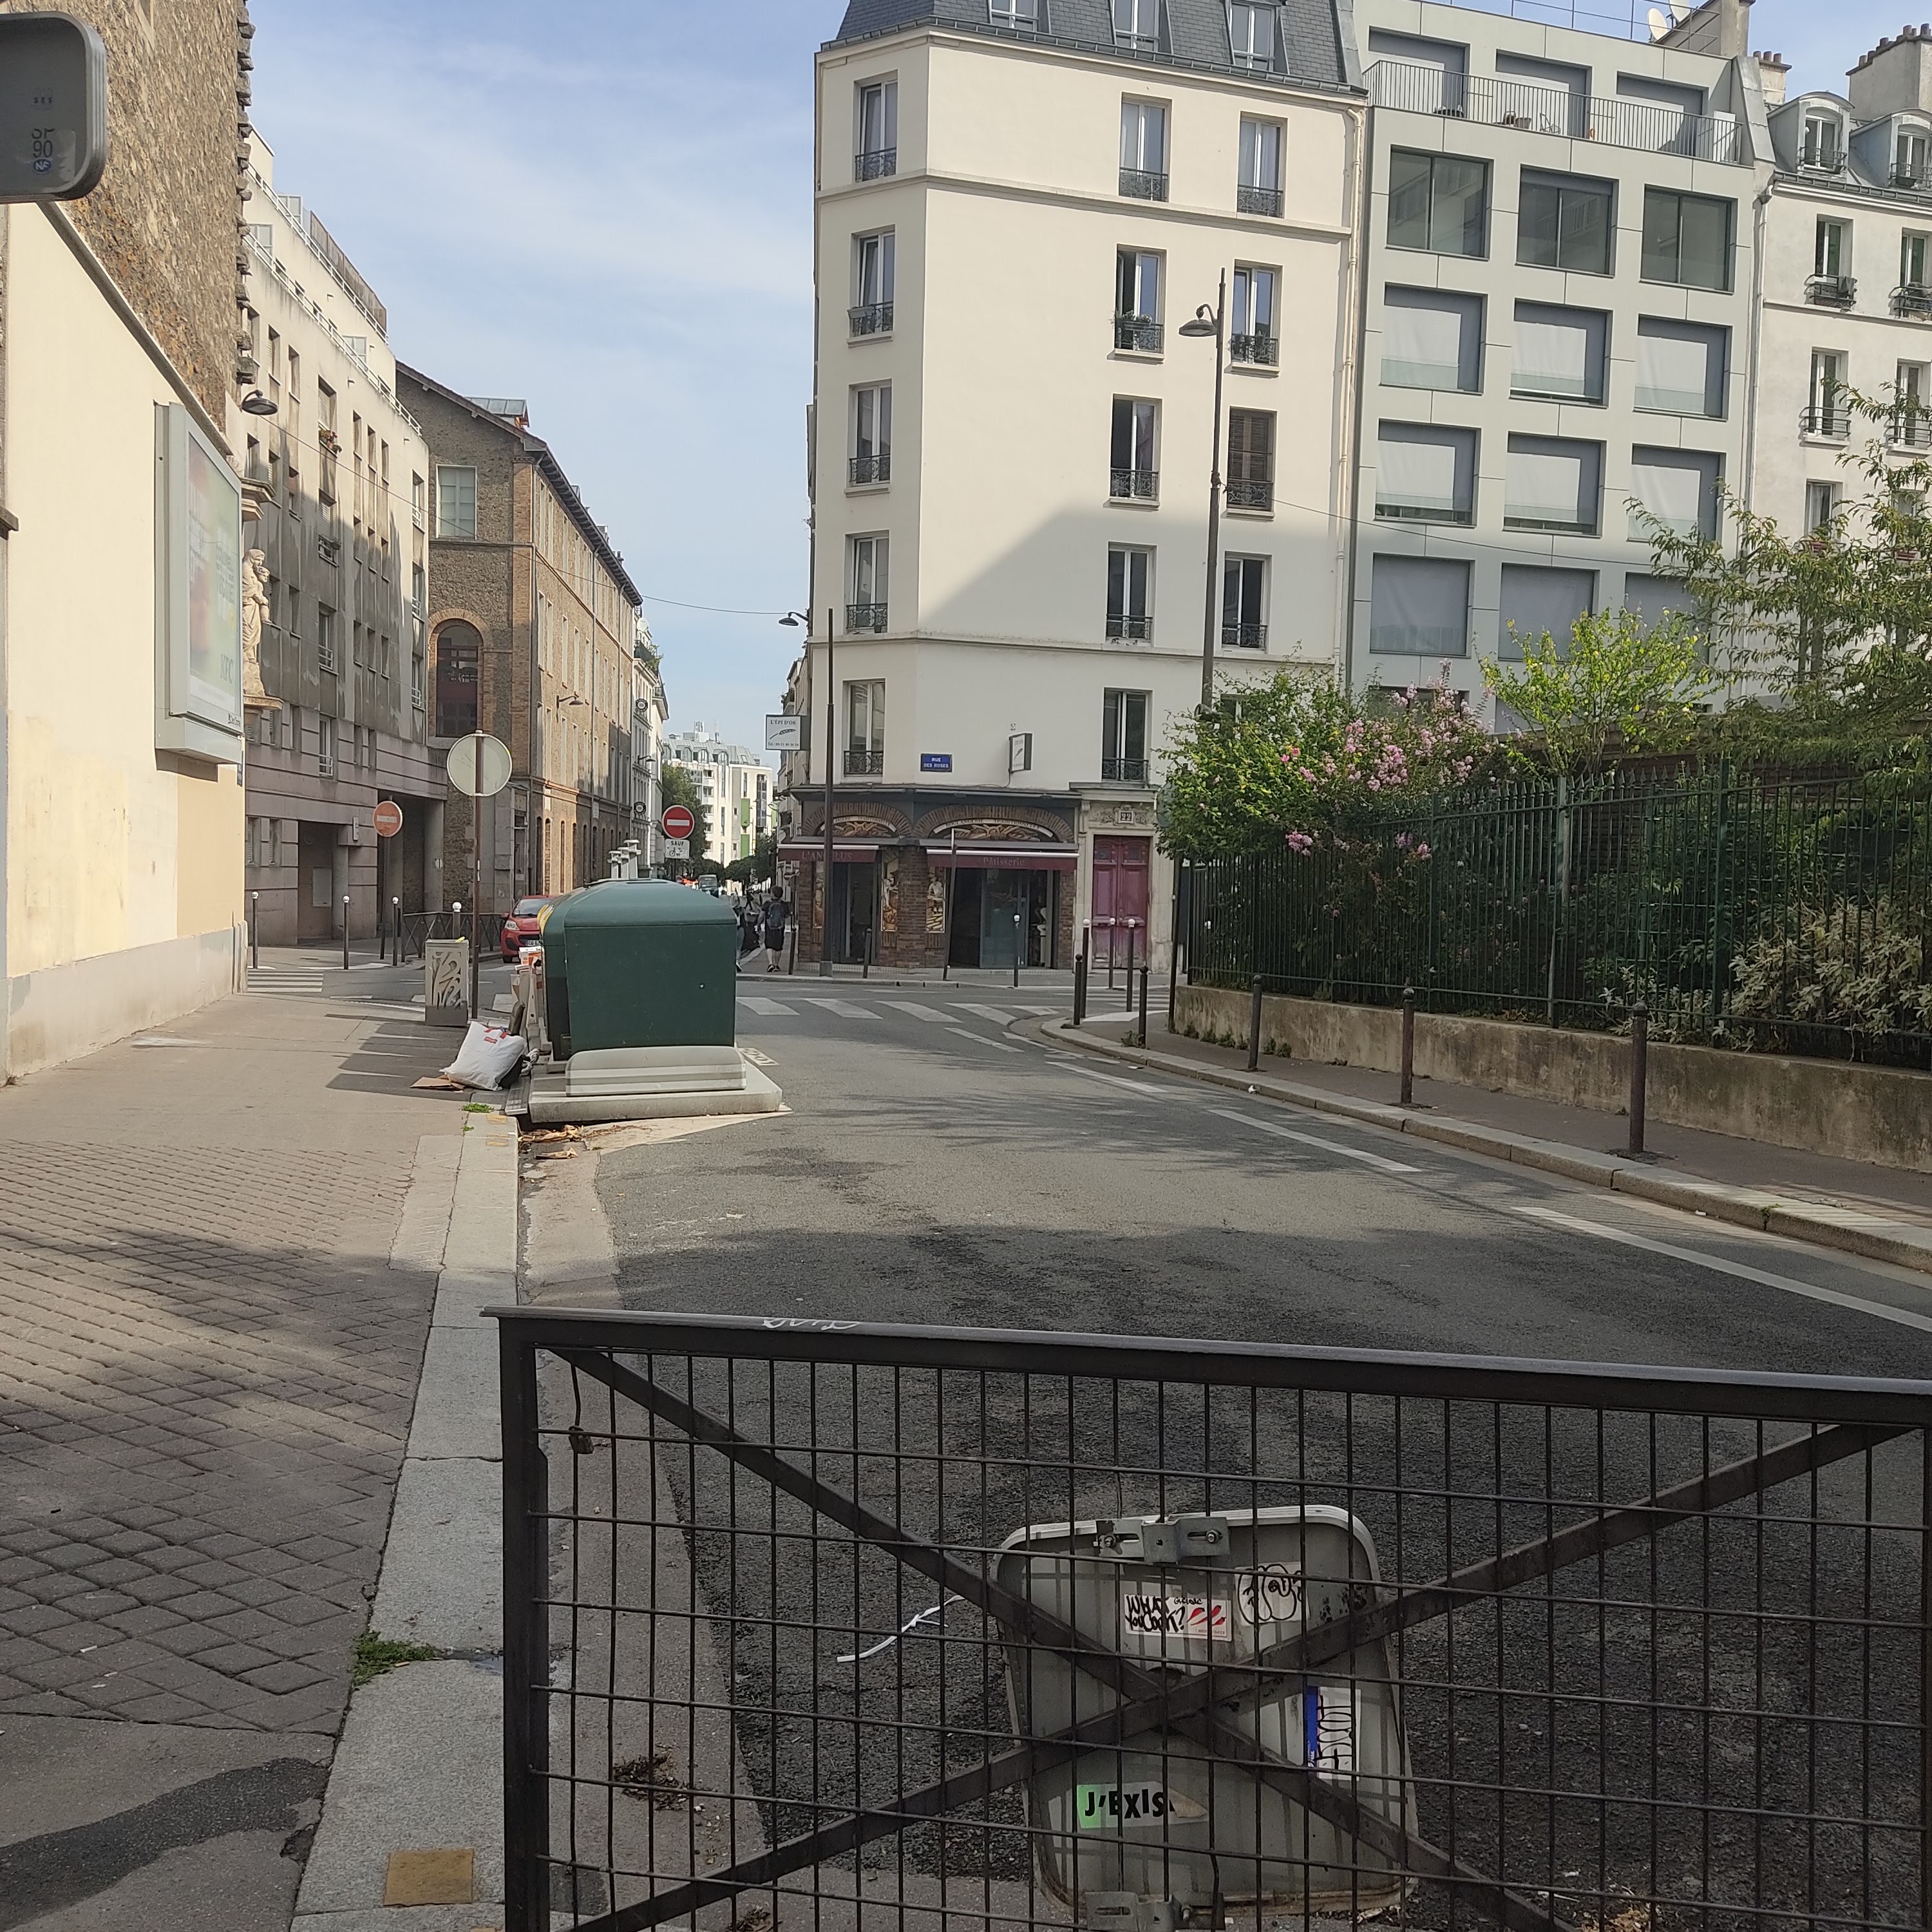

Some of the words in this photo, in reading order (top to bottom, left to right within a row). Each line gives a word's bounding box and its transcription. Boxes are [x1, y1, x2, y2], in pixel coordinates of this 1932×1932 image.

[33, 140, 52, 158] 90
[35, 160, 50, 170] NF
[220, 653, 233, 684] KFC
[1121, 813, 1132, 821] 22
